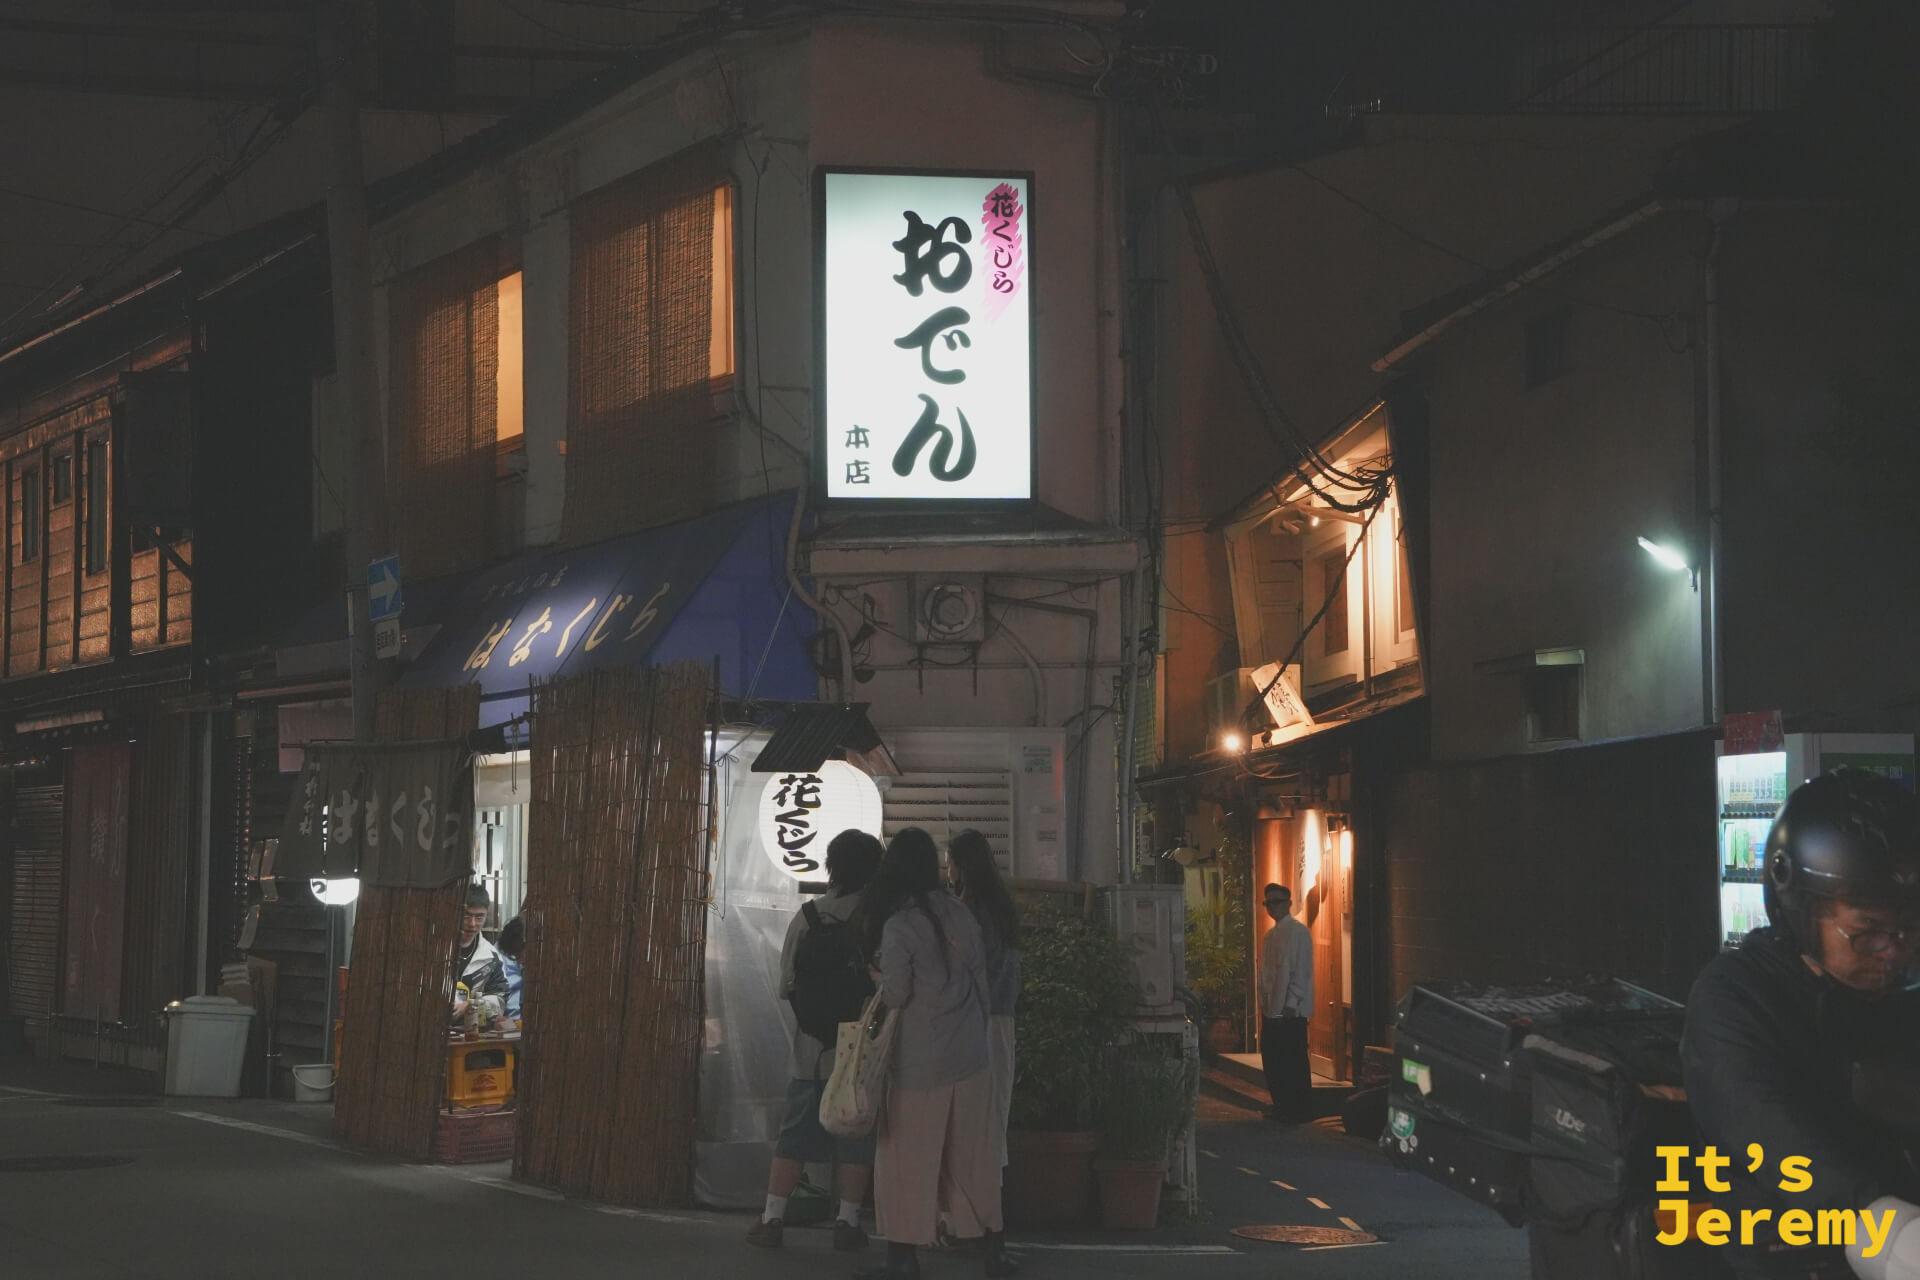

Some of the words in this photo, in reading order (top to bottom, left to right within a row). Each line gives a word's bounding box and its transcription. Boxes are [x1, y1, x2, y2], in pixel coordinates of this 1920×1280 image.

[992, 192, 1015, 294] 花くじら
[892, 210, 977, 482] おでん
[845, 424, 870, 484] 本店
[463, 582, 671, 672] はなくじら
[771, 773, 824, 873] 花くじら
